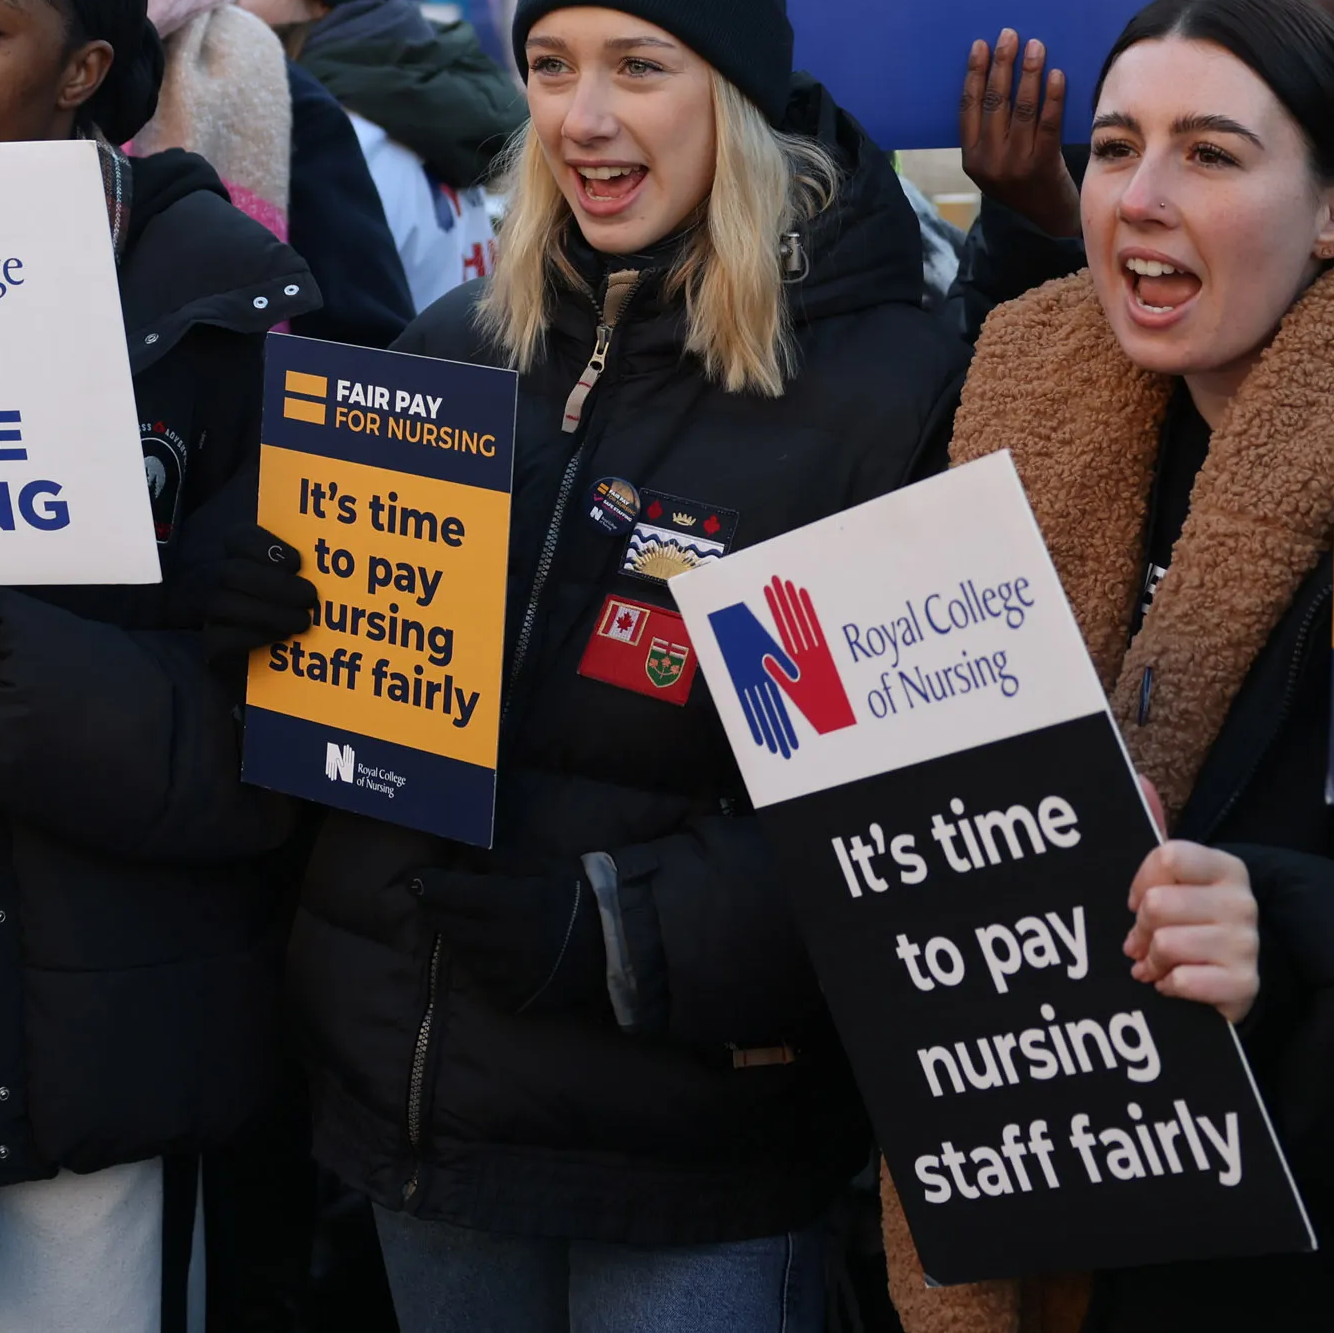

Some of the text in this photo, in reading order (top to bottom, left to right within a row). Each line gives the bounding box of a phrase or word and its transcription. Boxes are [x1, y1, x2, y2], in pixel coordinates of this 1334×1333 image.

[335, 406, 496, 457] FOR NURSING
[337, 379, 443, 419] FAIR PAY
[299, 477, 465, 548] It's time
[315, 538, 443, 607] to pay
[841, 575, 1036, 668] Royal College
[268, 640, 481, 729] staff fairly
[867, 647, 1020, 719] of Nursing
[356, 777, 395, 798] of Nursing
[357, 763, 407, 788] Royal College
[831, 795, 1081, 898] It's time
[896, 906, 1089, 993] to pay
[917, 1003, 1162, 1097] nursing
[914, 1099, 1243, 1203] staff fairly
